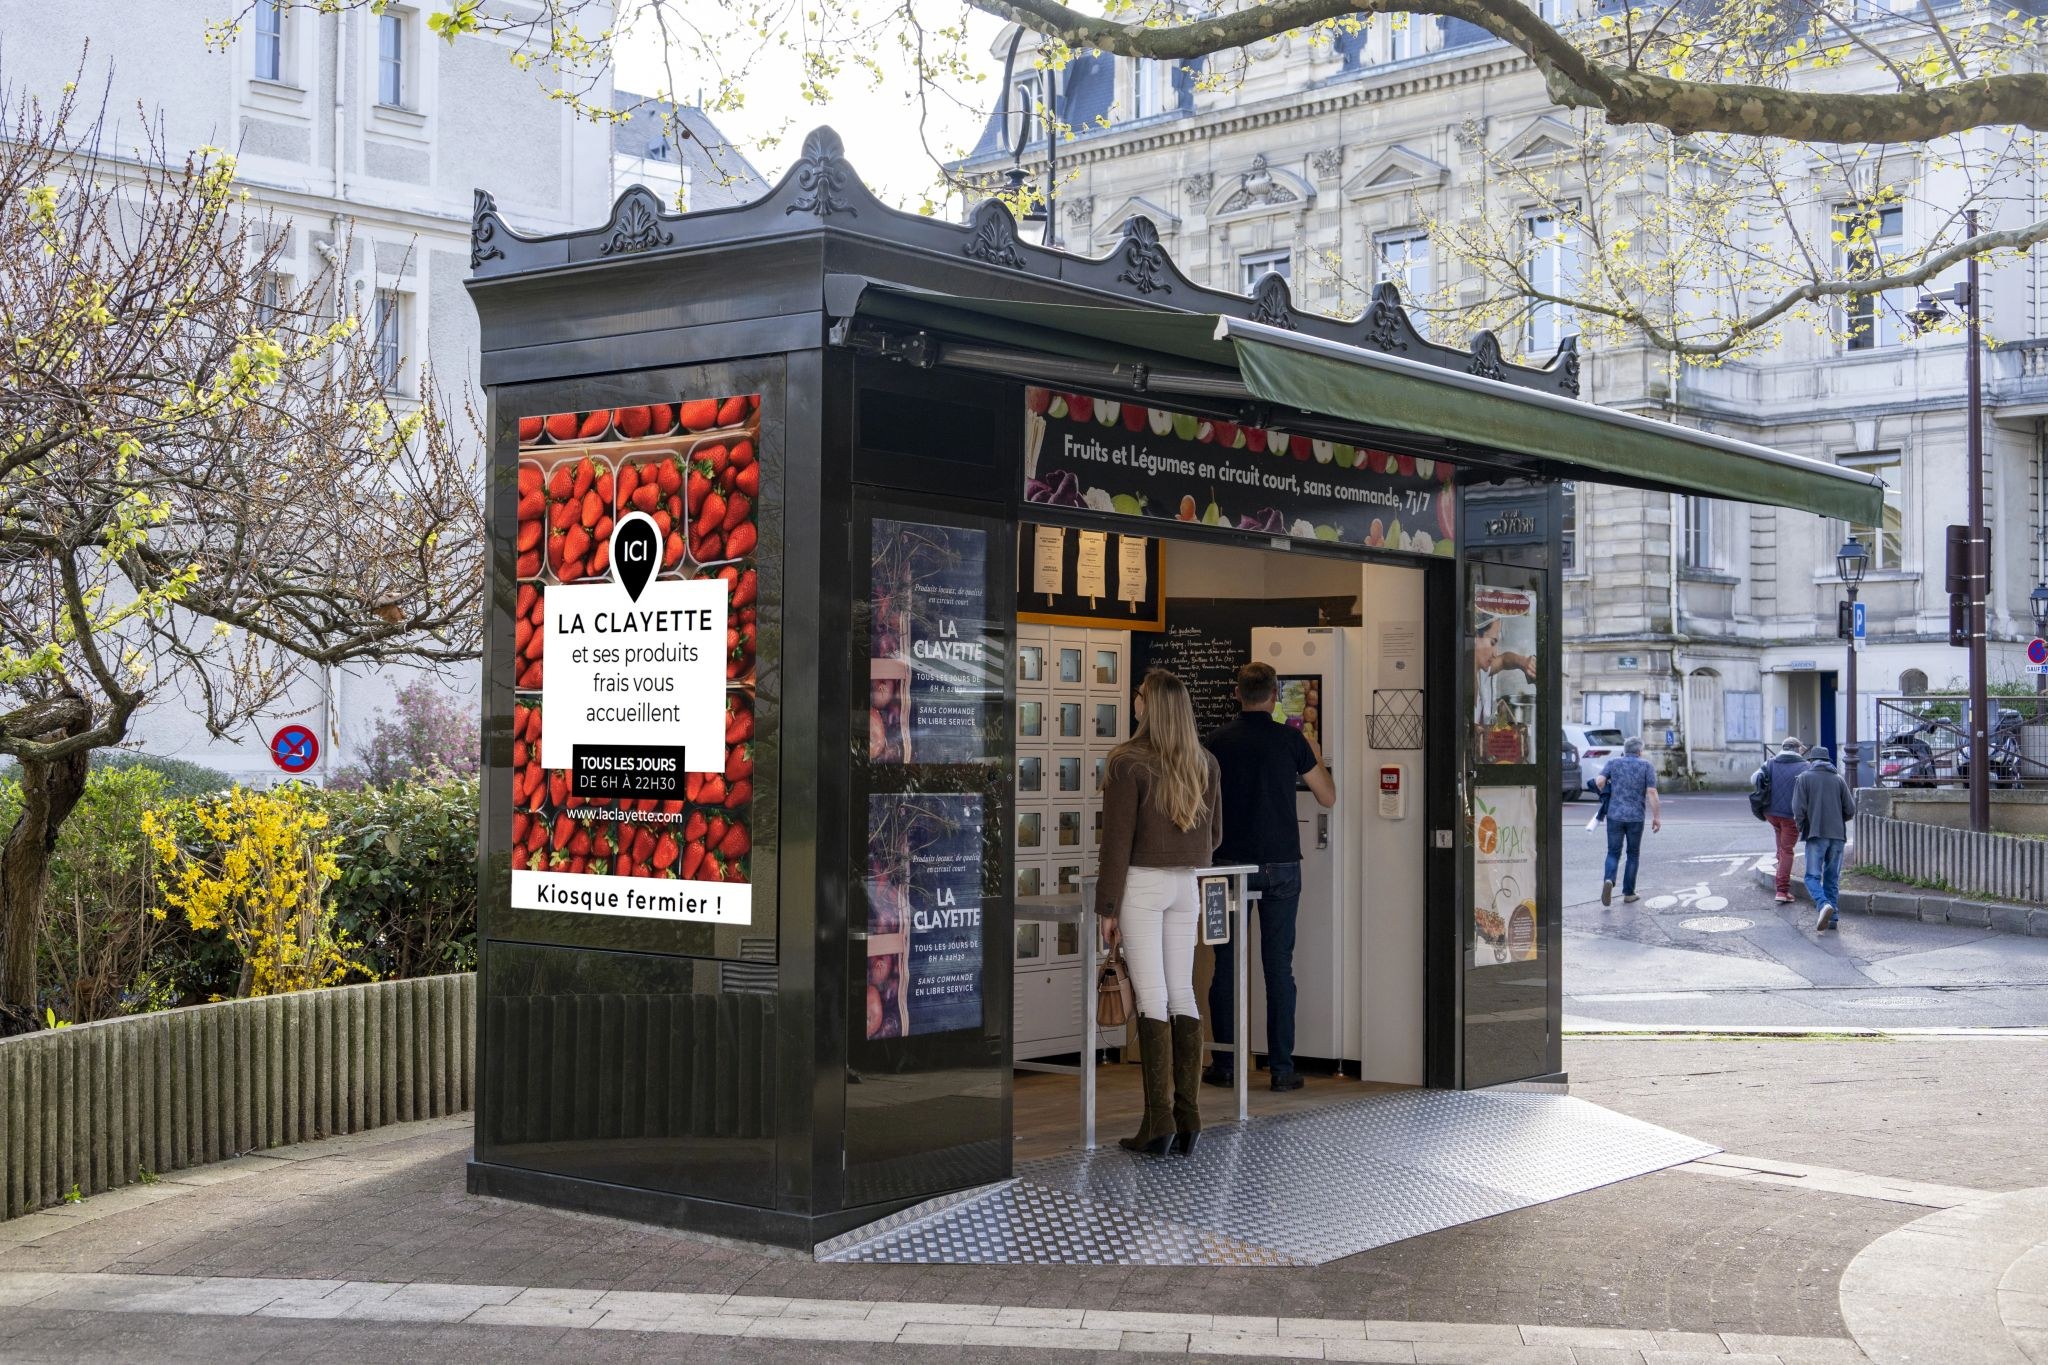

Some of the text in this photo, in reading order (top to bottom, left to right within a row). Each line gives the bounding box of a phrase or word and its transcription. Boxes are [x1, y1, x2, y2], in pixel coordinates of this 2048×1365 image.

[1064, 434, 1431, 516] Fruits et Légumes en circuit court, sans commande, 7j/7
[624, 540, 647, 562] ICI
[558, 609, 713, 634] LA CLAYETTE
[939, 619, 958, 639] LA
[572, 641, 699, 667] et ses produits
[913, 638, 983, 662] CLAYETTE
[593, 672, 674, 693] frais vous
[916, 673, 981, 683] TOUS LES JOURS DE
[586, 702, 680, 722] accueillent
[919, 706, 976, 715] SANS COMMANDE
[917, 717, 976, 726] EN LIBRE SERVICE
[581, 756, 676, 772] TOUS LES JOURS
[580, 772, 676, 790] DE 6H À 22H30
[566, 807, 683, 825] www.laclayette.com
[537, 884, 722, 915] Kiosque fermier !
[936, 887, 956, 907] LA
[913, 907, 981, 931] CLAYETTE
[914, 940, 979, 953] TOUS LES JOURS DE
[928, 955, 938, 963] 6H
[917, 973, 974, 985] SANS COMMANDE
[915, 984, 974, 996] EN LIBRE SERVICE
